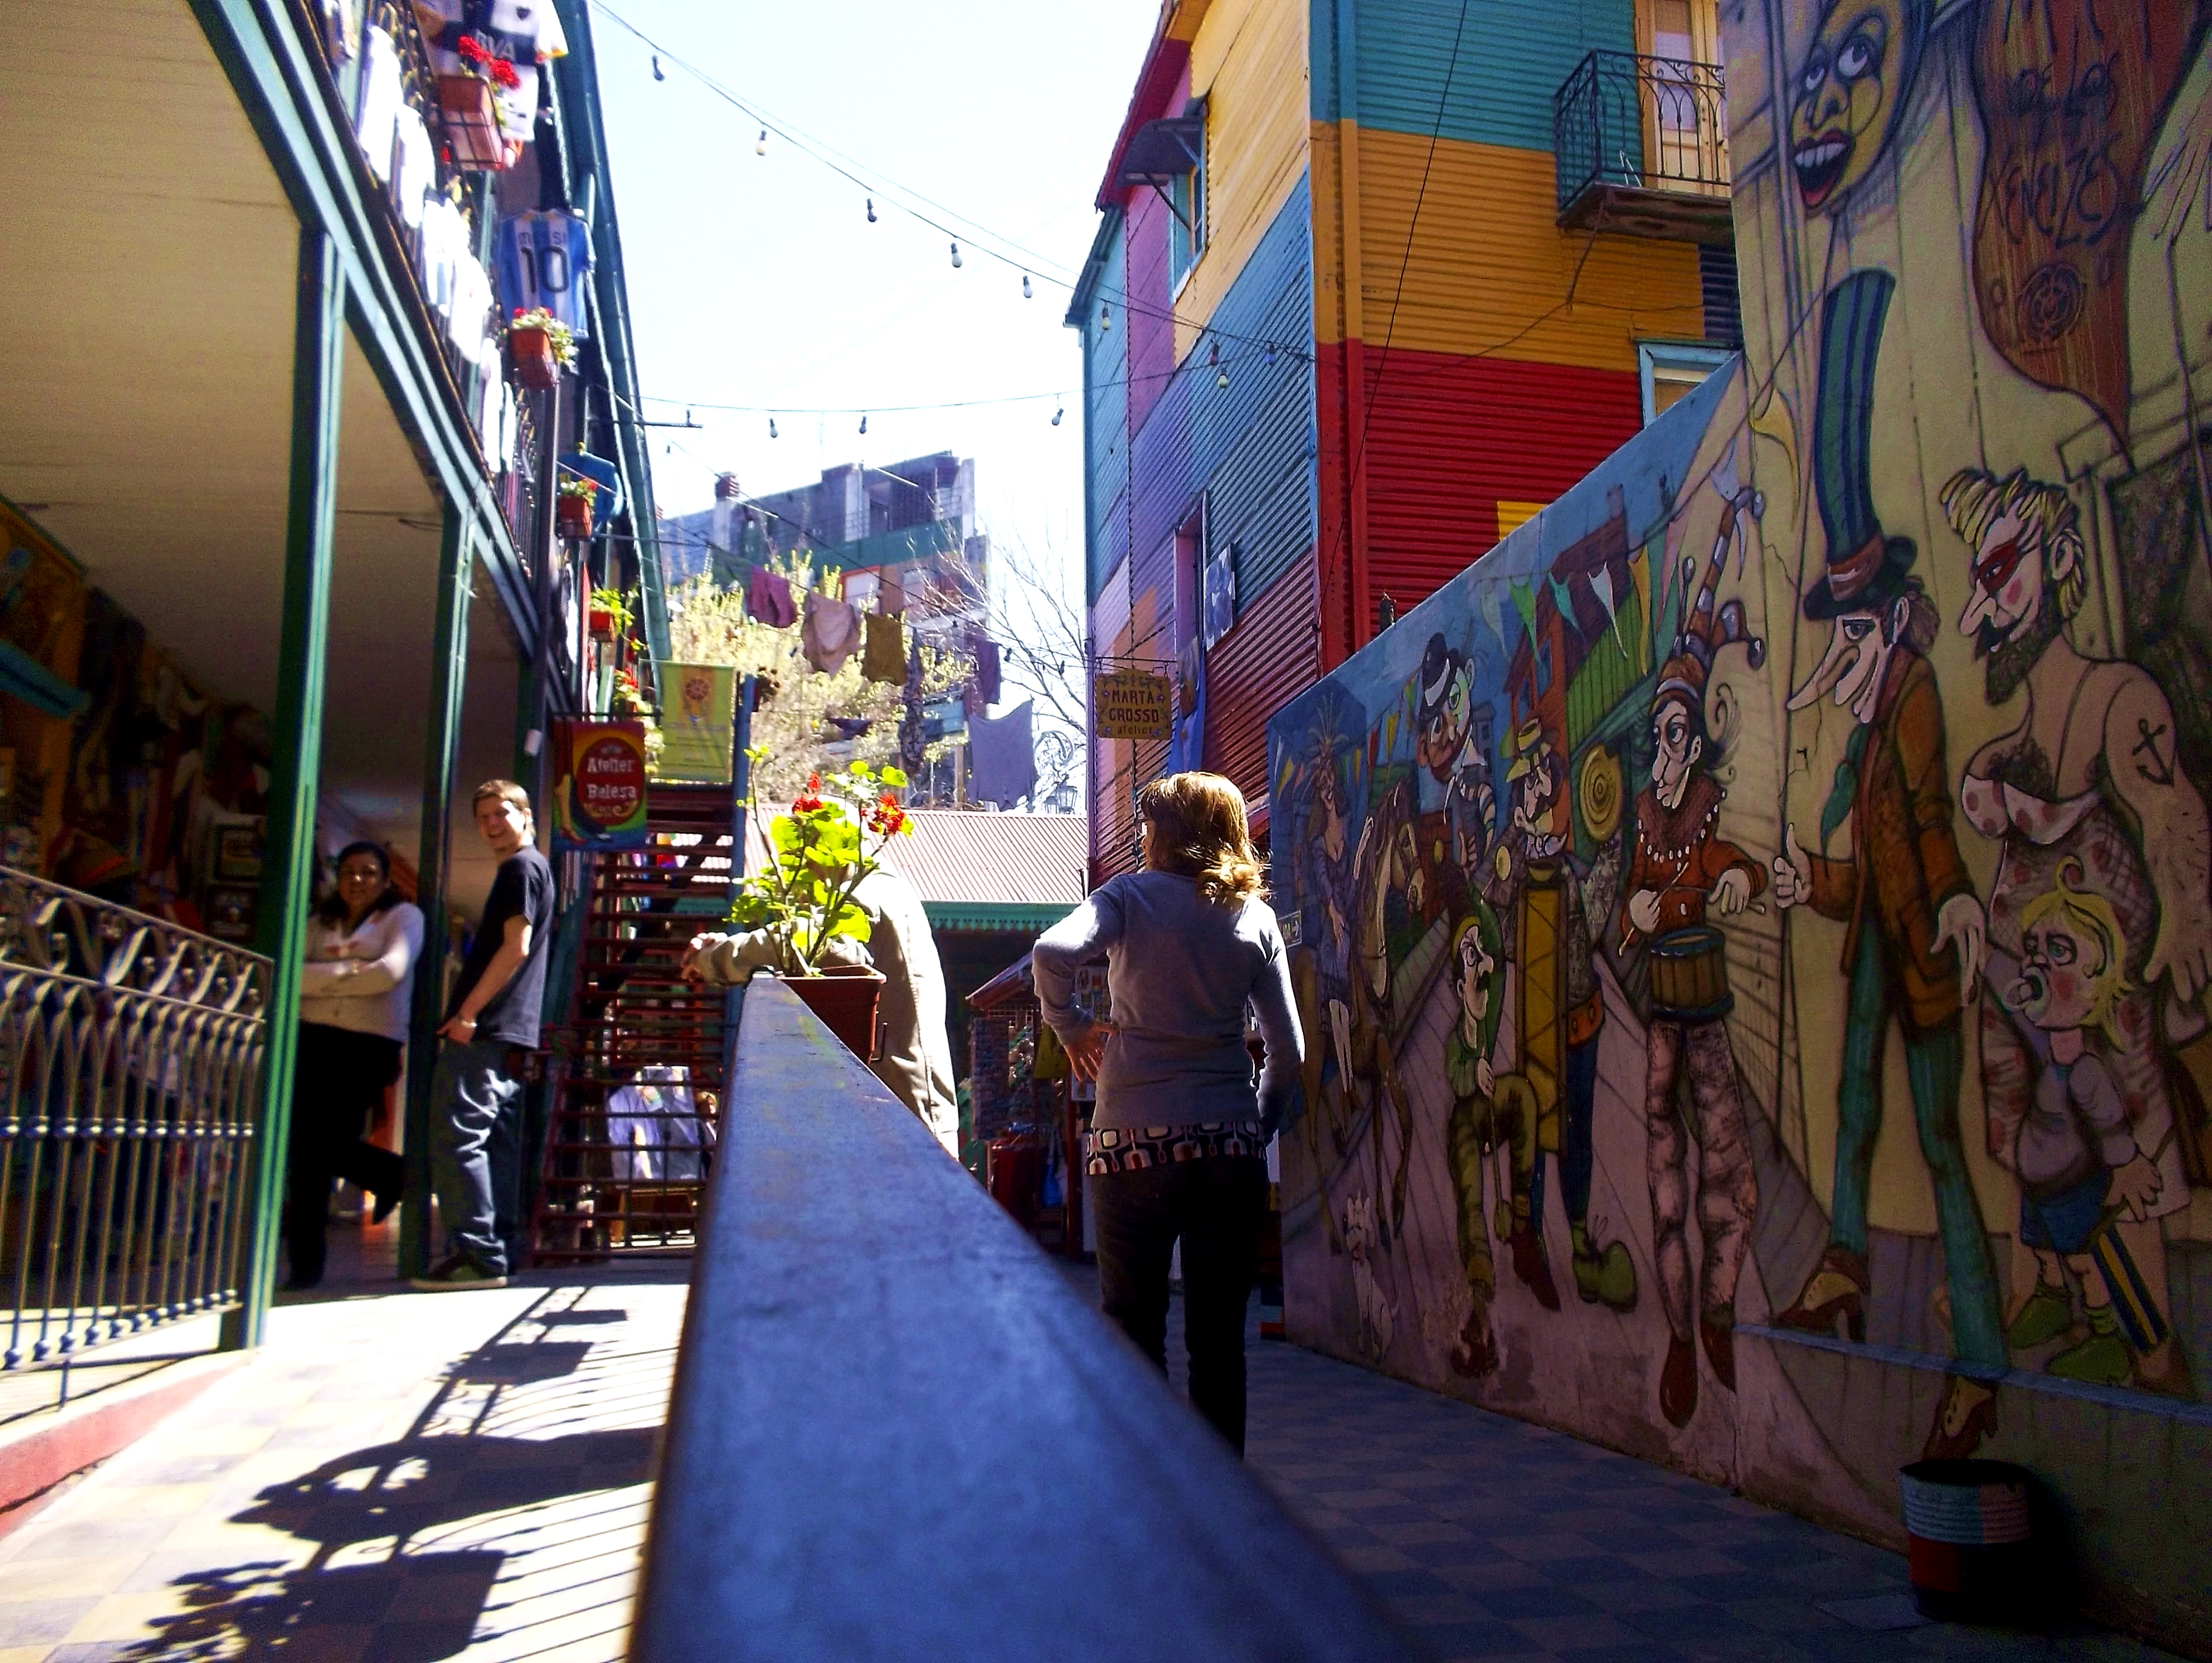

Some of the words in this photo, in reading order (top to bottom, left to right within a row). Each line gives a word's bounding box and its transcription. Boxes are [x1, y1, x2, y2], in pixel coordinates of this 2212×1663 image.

[521, 246, 569, 294] 10
[1111, 689, 1155, 705] MARTA
[1108, 708, 1159, 723] GROSSO
